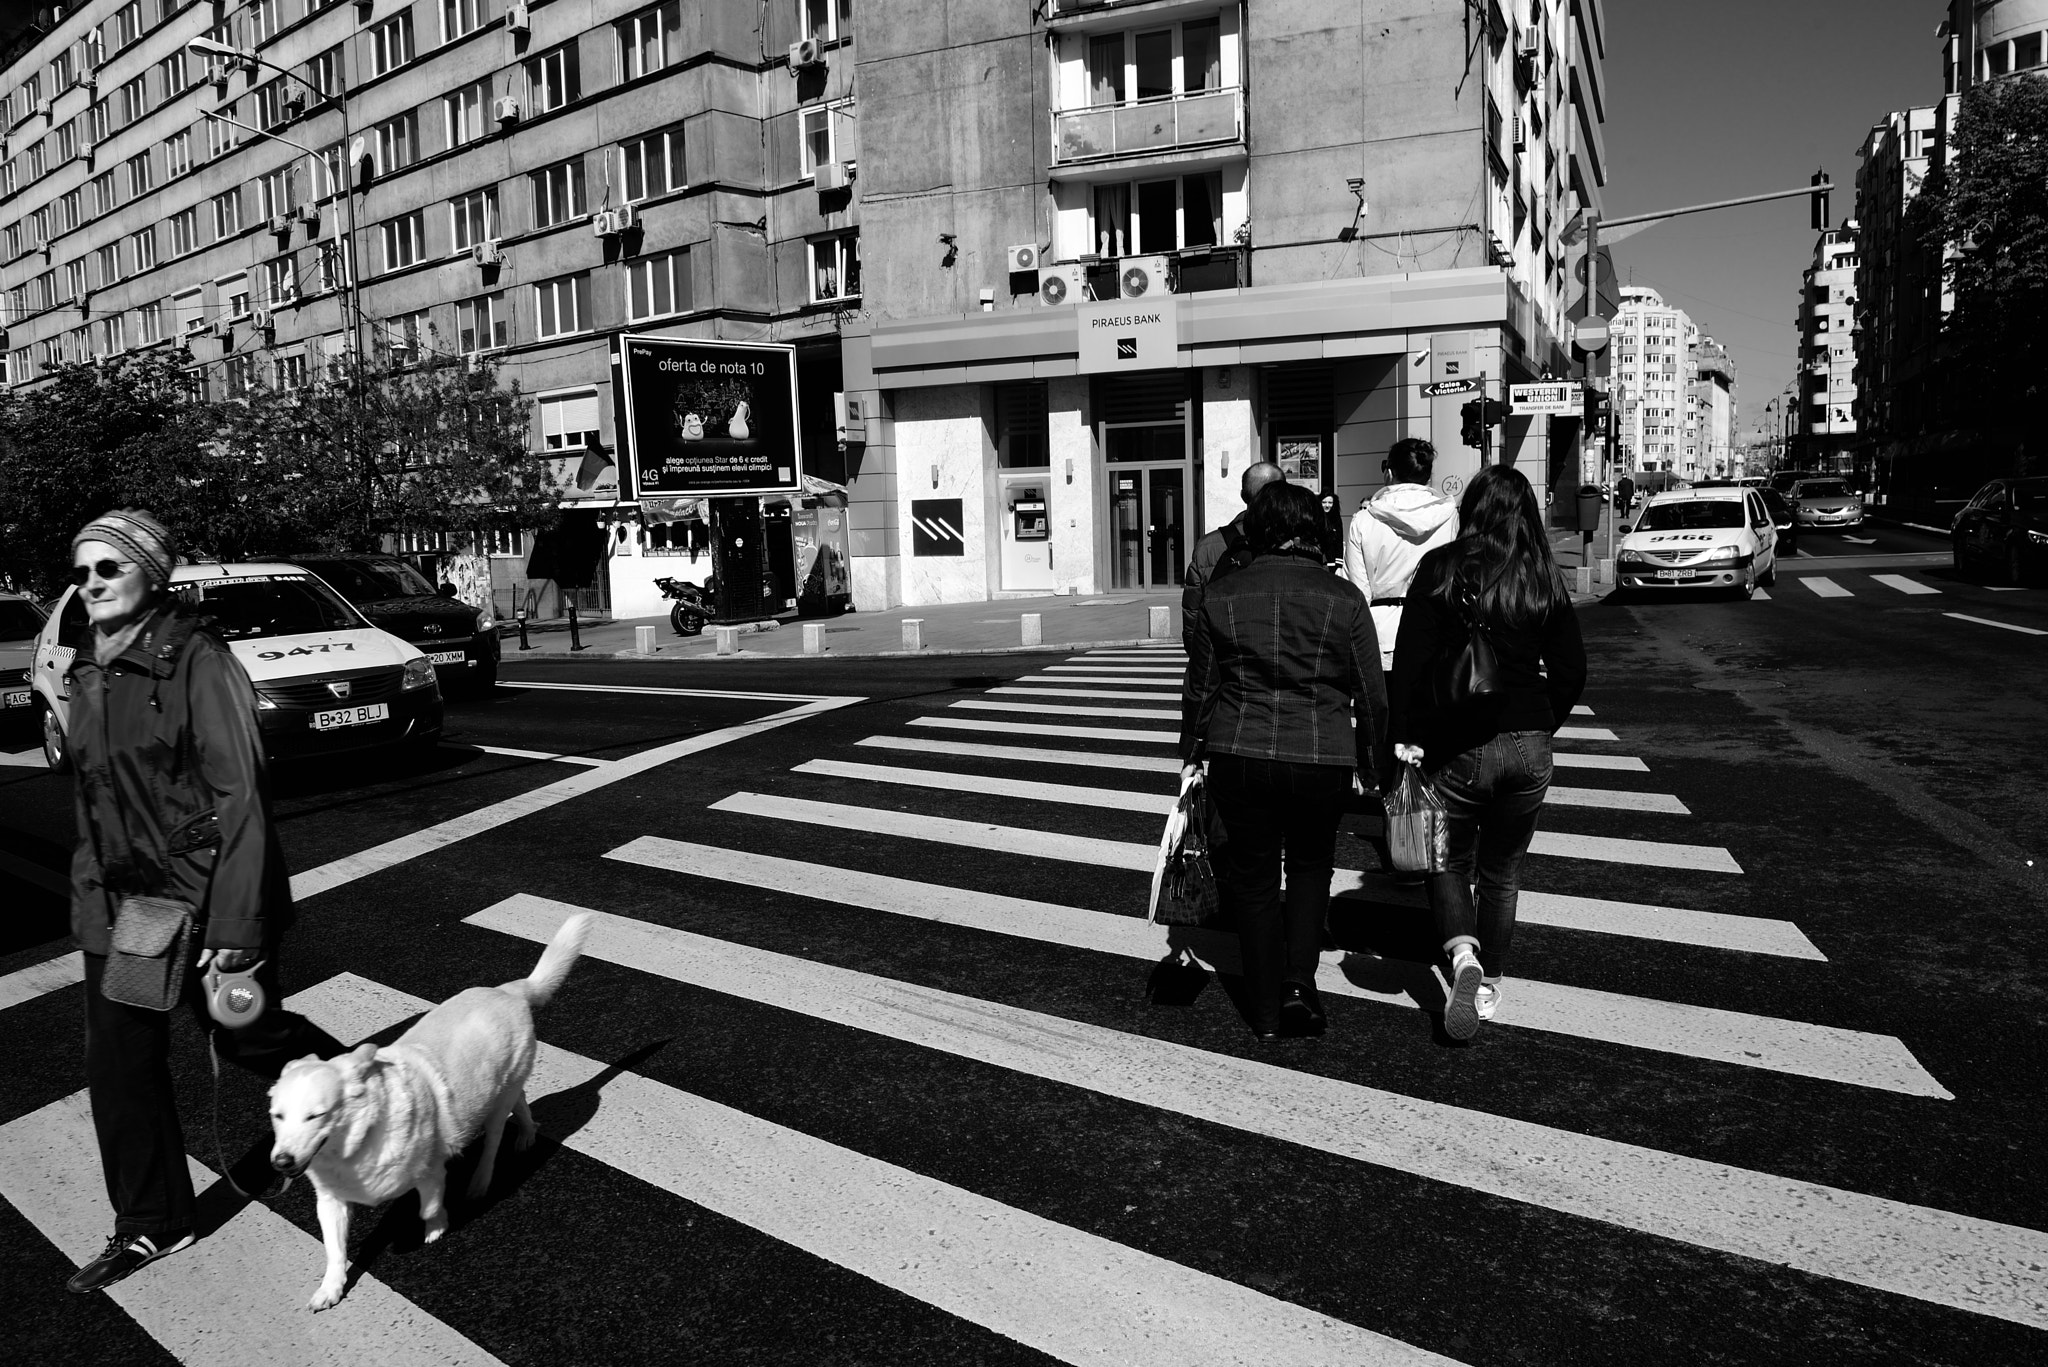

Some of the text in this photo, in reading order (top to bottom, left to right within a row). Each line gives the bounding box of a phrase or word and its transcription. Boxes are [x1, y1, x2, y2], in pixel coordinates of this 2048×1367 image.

[1092, 314, 1161, 328] PIRAEUS BANK
[633, 348, 652, 356] PrePay
[659, 358, 764, 375] oferta de nota 10
[1434, 386, 1467, 395] Victoriei
[1514, 388, 1558, 396] WESTERN
[666, 457, 684, 466] alege
[748, 464, 772, 472] olimpici
[641, 469, 659, 481] 4G
[1446, 481, 1458, 491] 24
[1650, 534, 1714, 542] 9466
[1677, 569, 1693, 577] ZRB
[257, 642, 355, 662] 9477
[434, 654, 444, 662] 20
[446, 652, 463, 662] XMM
[12, 694, 26, 704] AG
[336, 711, 352, 724] 32
[357, 705, 382, 721] BLJ
